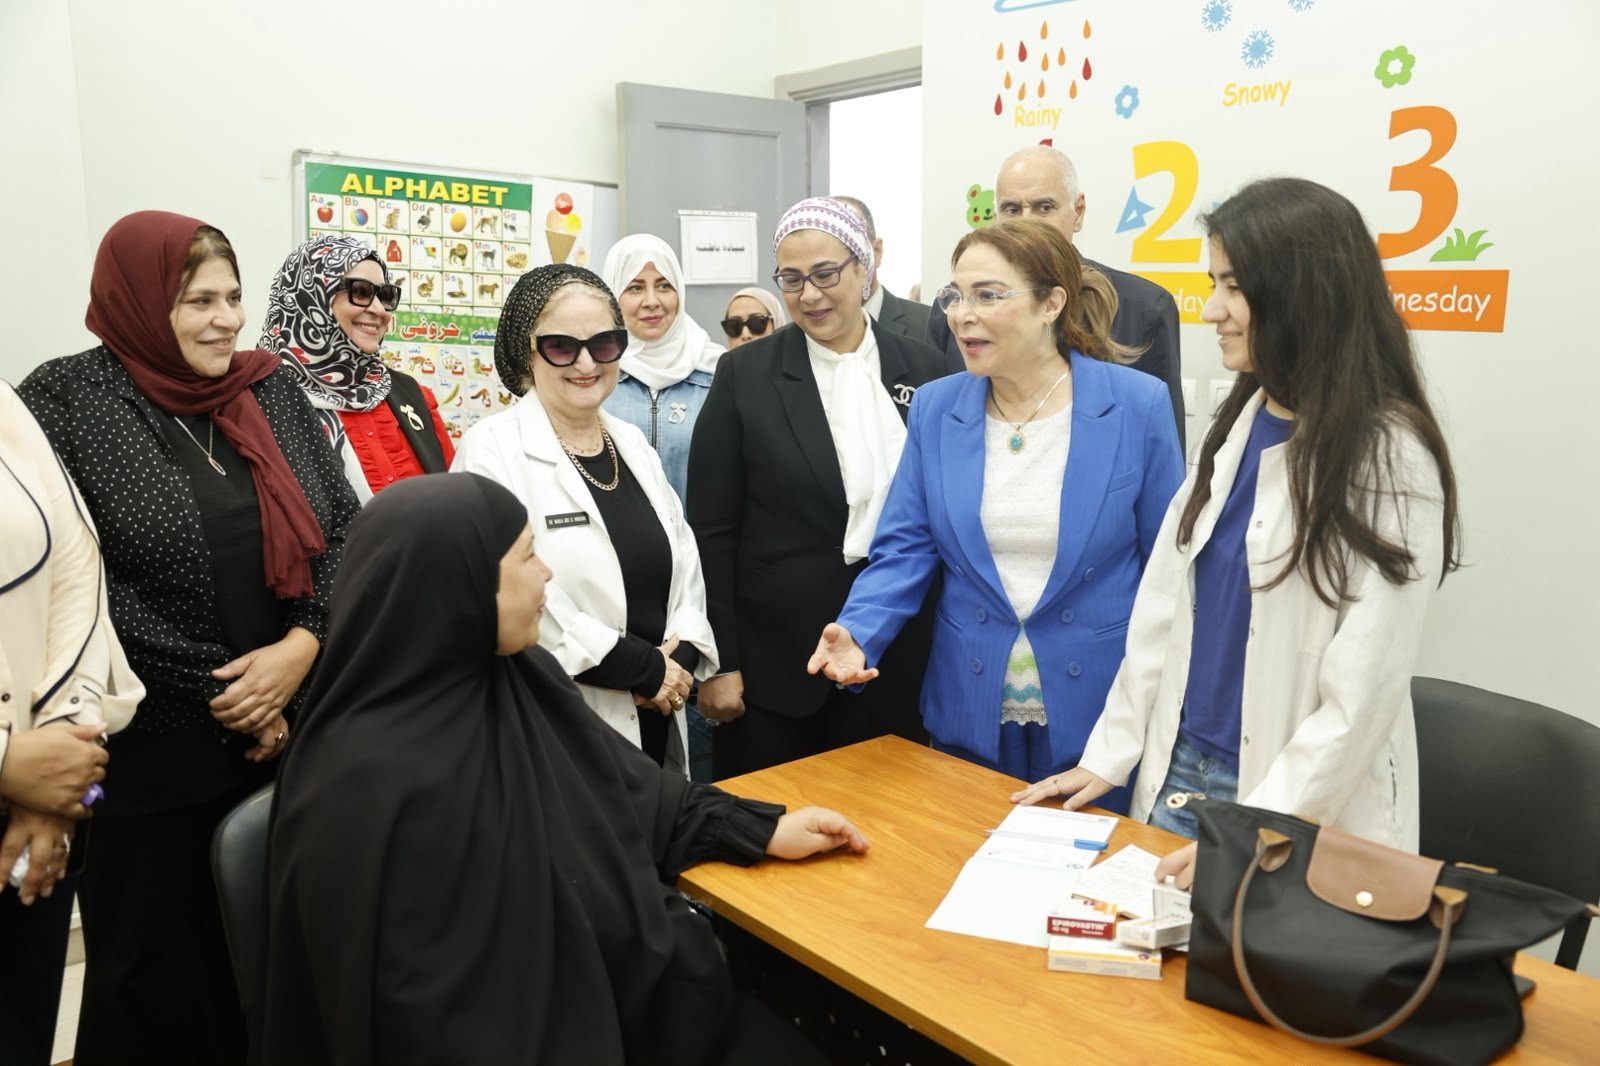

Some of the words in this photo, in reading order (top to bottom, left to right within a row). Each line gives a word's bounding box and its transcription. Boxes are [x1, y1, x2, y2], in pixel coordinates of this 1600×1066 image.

[1222, 79, 1292, 107] Snowy
[1013, 102, 1062, 132] Rainy
[340, 172, 509, 206] ALPHABET
[1377, 105, 1459, 259] 3
[1130, 140, 1203, 263] 2
[1387, 284, 1492, 322] nesday
